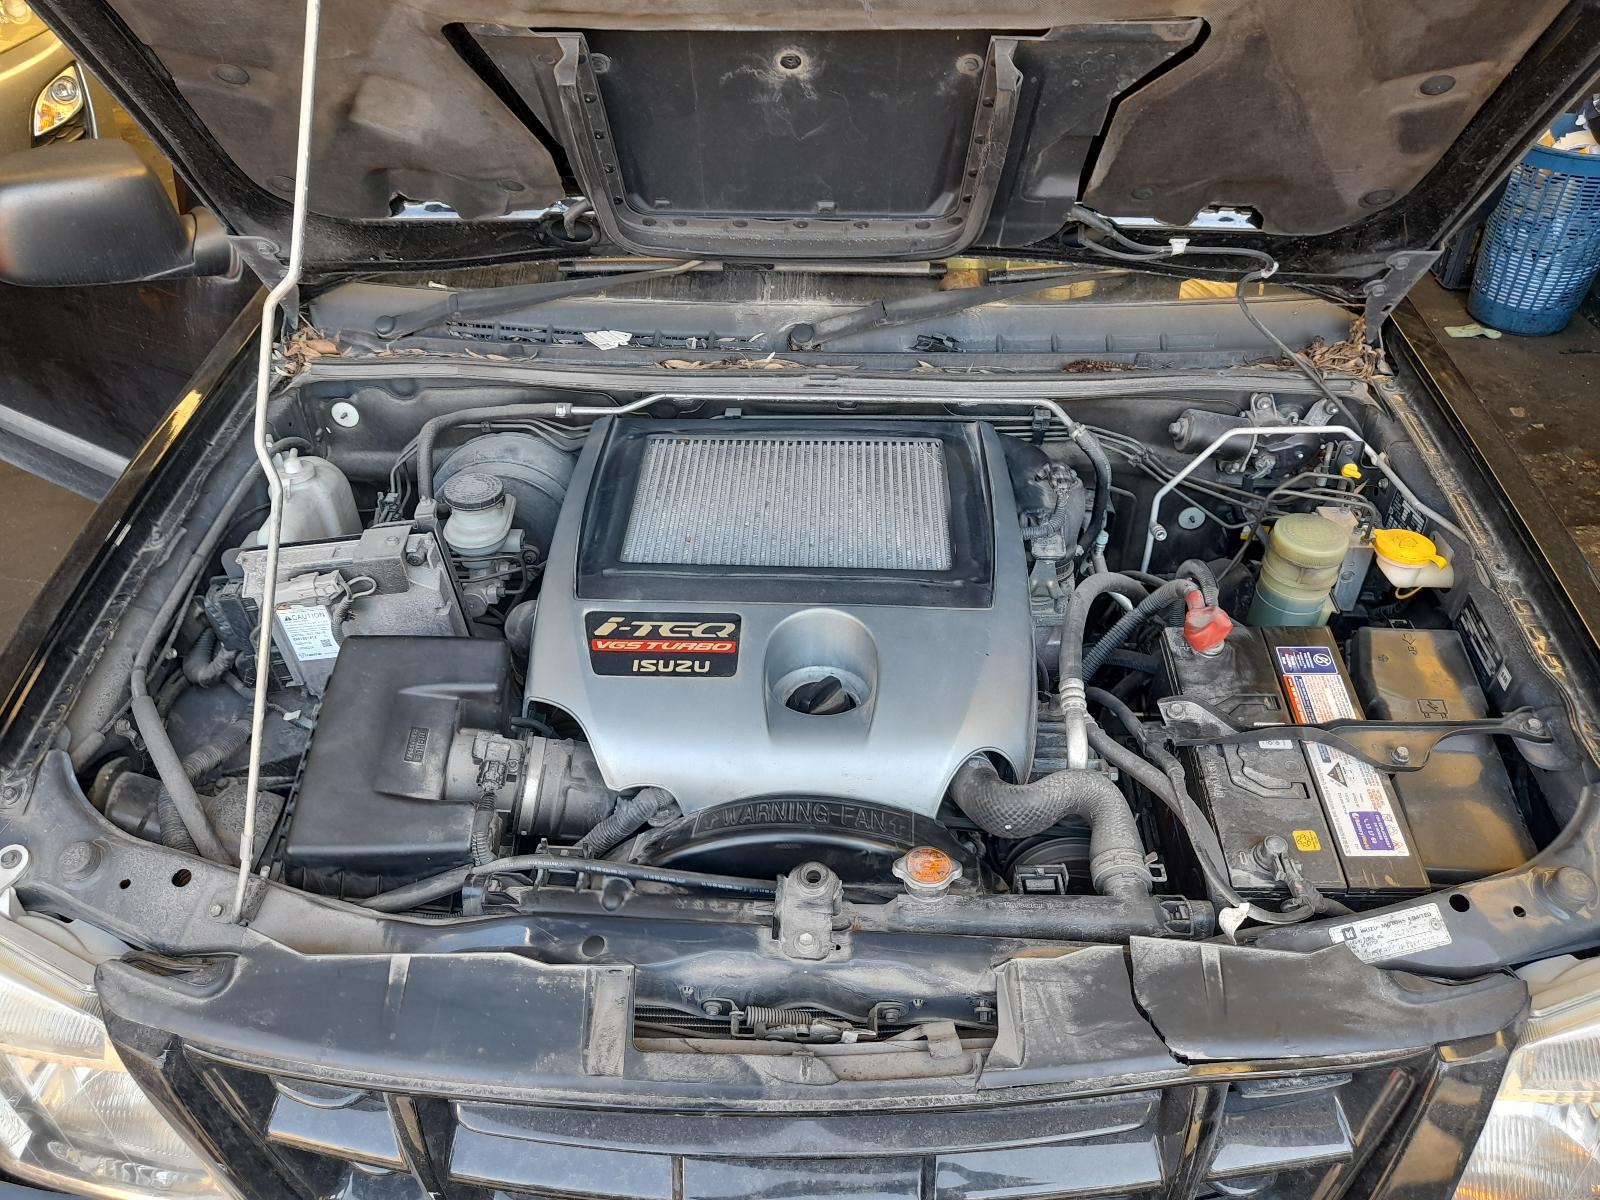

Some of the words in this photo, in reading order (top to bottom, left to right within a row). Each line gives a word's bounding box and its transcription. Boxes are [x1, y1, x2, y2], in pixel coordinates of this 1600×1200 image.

[596, 640, 644, 650] VGS
[647, 641, 733, 651] TURBO
[632, 659, 711, 673] ISUZU
